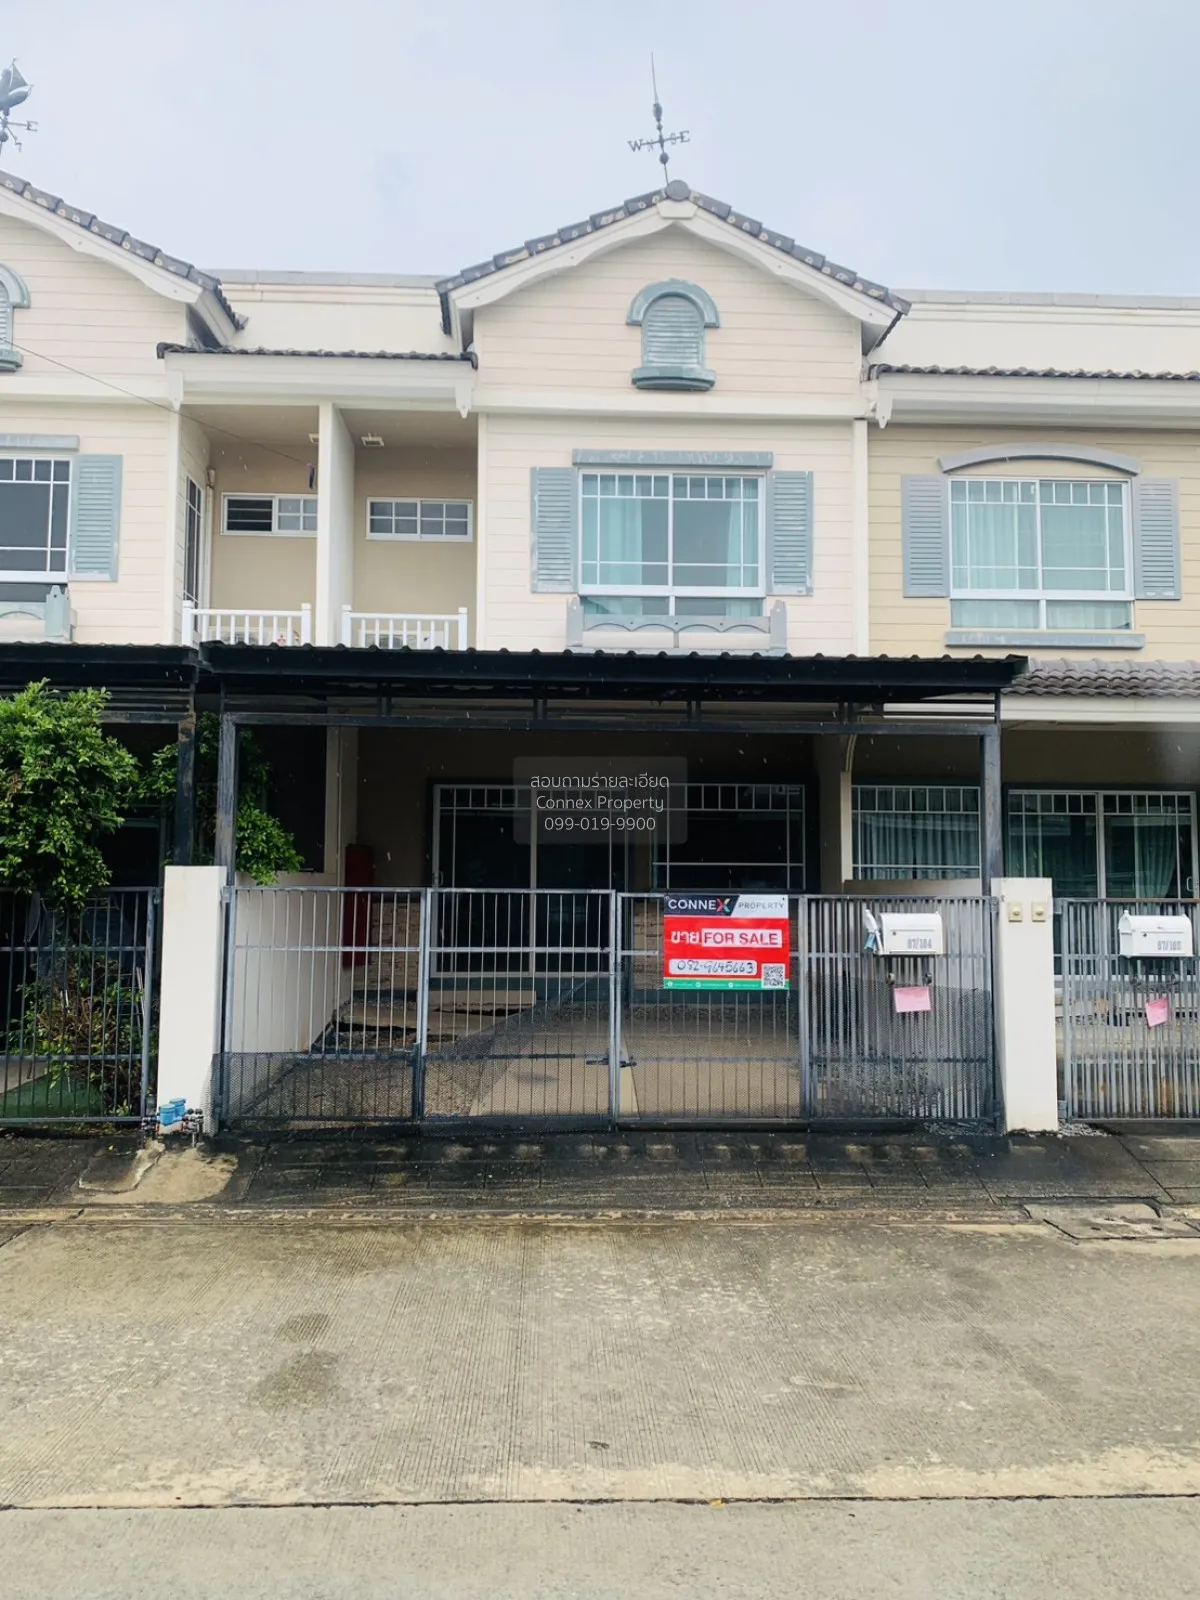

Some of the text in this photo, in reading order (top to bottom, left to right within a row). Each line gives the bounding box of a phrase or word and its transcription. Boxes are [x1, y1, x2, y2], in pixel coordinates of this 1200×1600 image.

[627, 138, 643, 152] W
[679, 130, 690, 143] E
[668, 898, 784, 912] CONNEX PROPERTY
[671, 930, 700, 944] ขาย
[704, 932, 778, 945] FOR SALE
